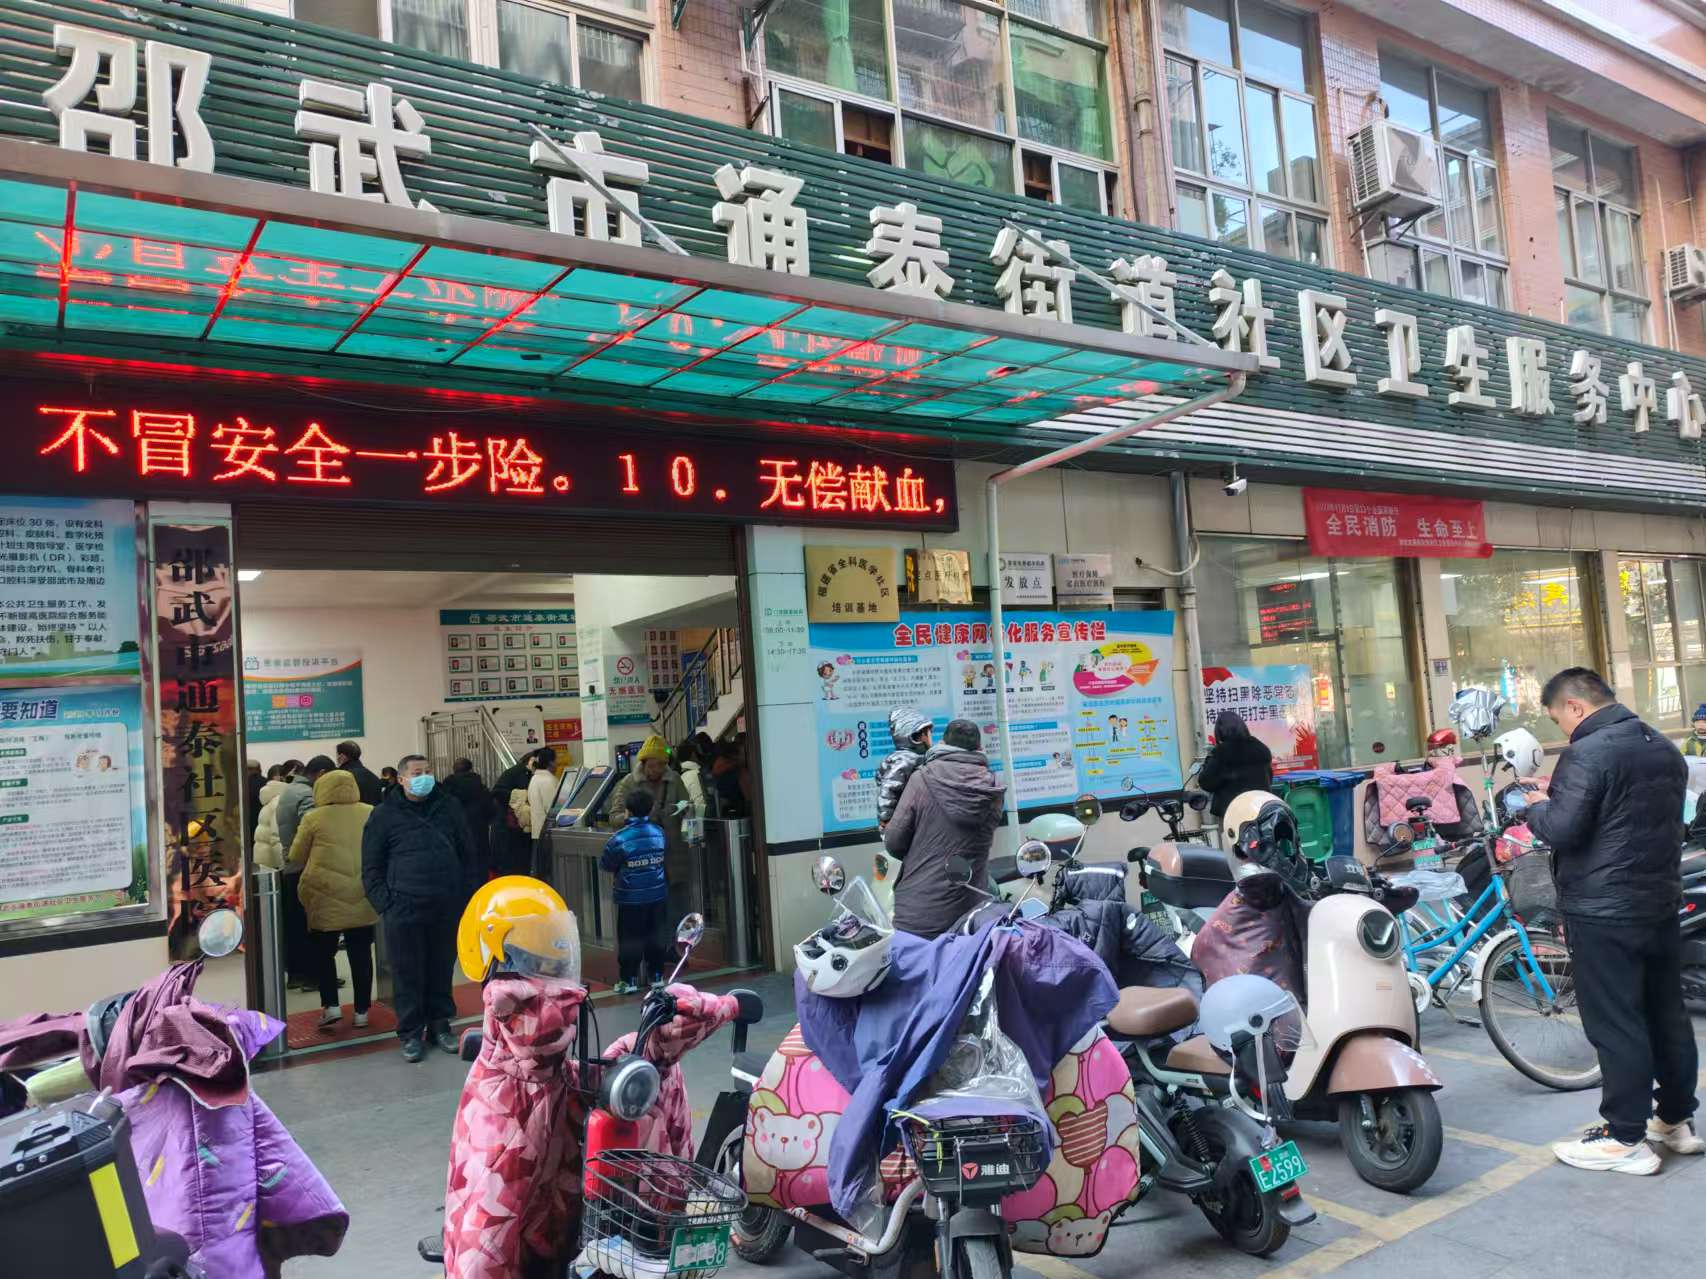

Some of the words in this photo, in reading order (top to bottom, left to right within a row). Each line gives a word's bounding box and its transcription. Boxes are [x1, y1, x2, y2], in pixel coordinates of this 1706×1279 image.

[39, 406, 570, 496] 不冒安全一步险。
[1325, 513, 1396, 537] 全民消防
[1417, 517, 1478, 540] 生命至上
[1004, 576, 1042, 589] 发放点
[832, 601, 880, 614] 培训基地
[894, 622, 1106, 646] 全民健康网化服务宣传栏
[0, 699, 58, 721] 要知道
[980, 1163, 1010, 1176] 雅迪
